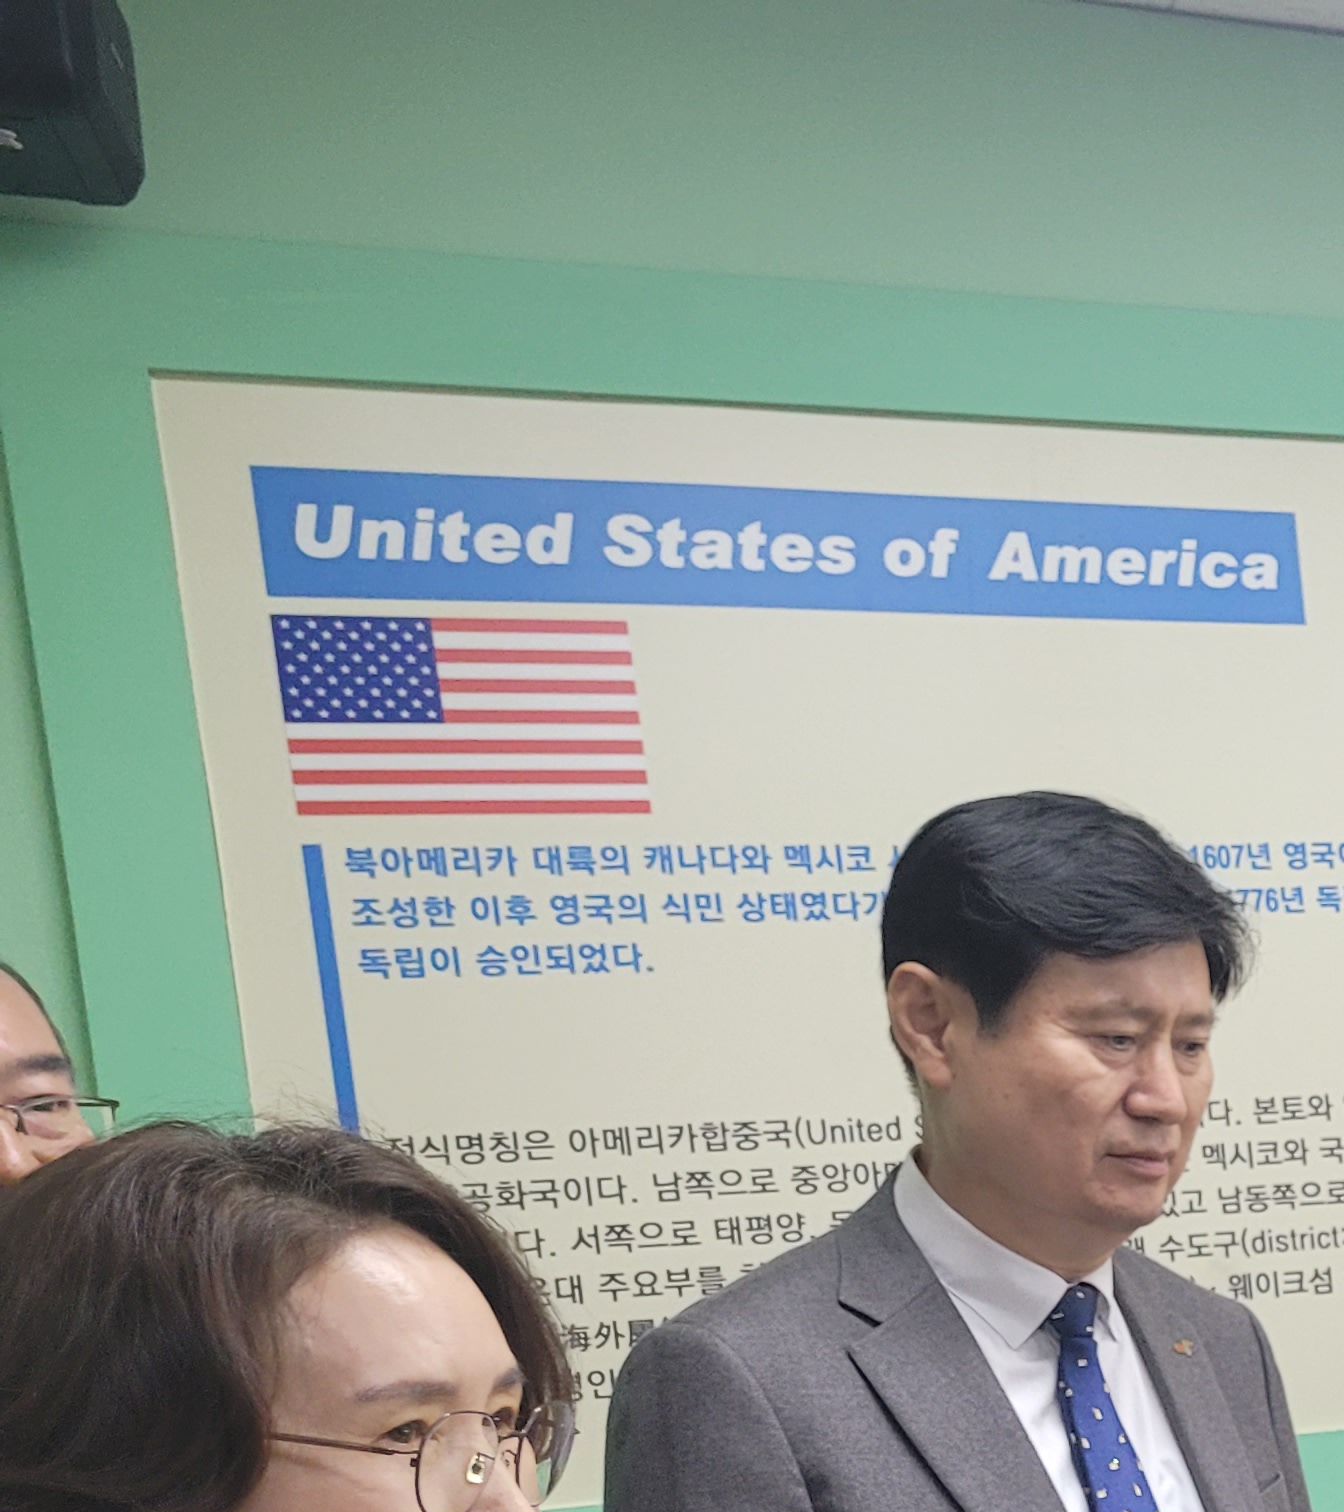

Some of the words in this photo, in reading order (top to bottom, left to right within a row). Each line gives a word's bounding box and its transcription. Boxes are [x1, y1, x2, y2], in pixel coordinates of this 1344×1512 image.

[295, 504, 573, 566] United
[605, 513, 856, 574] States
[883, 527, 957, 579] of
[988, 530, 1280, 591] America
[344, 845, 518, 879] 북아메리카
[532, 844, 630, 877] 대륙의
[643, 844, 773, 875] 캐나다와
[783, 844, 877, 875] 멕시코
[1189, 843, 1272, 870] 1607년
[352, 896, 456, 929] 조성한
[470, 894, 537, 927] 이후
[549, 893, 648, 926] 영국의
[662, 892, 724, 924] 식민
[1236, 886, 1305, 914] 776년
[357, 946, 461, 980] 독립이
[475, 942, 654, 977] 승인되었다.
[568, 1115, 902, 1159] 아메리카합중국(United
[1253, 1093, 1333, 1125] 본토와
[652, 1168, 780, 1203] 남쪽으로
[1201, 1138, 1309, 1171] 멕시코와
[571, 1220, 702, 1255] 서쪽으로
[598, 1265, 727, 1303] 주요부를
